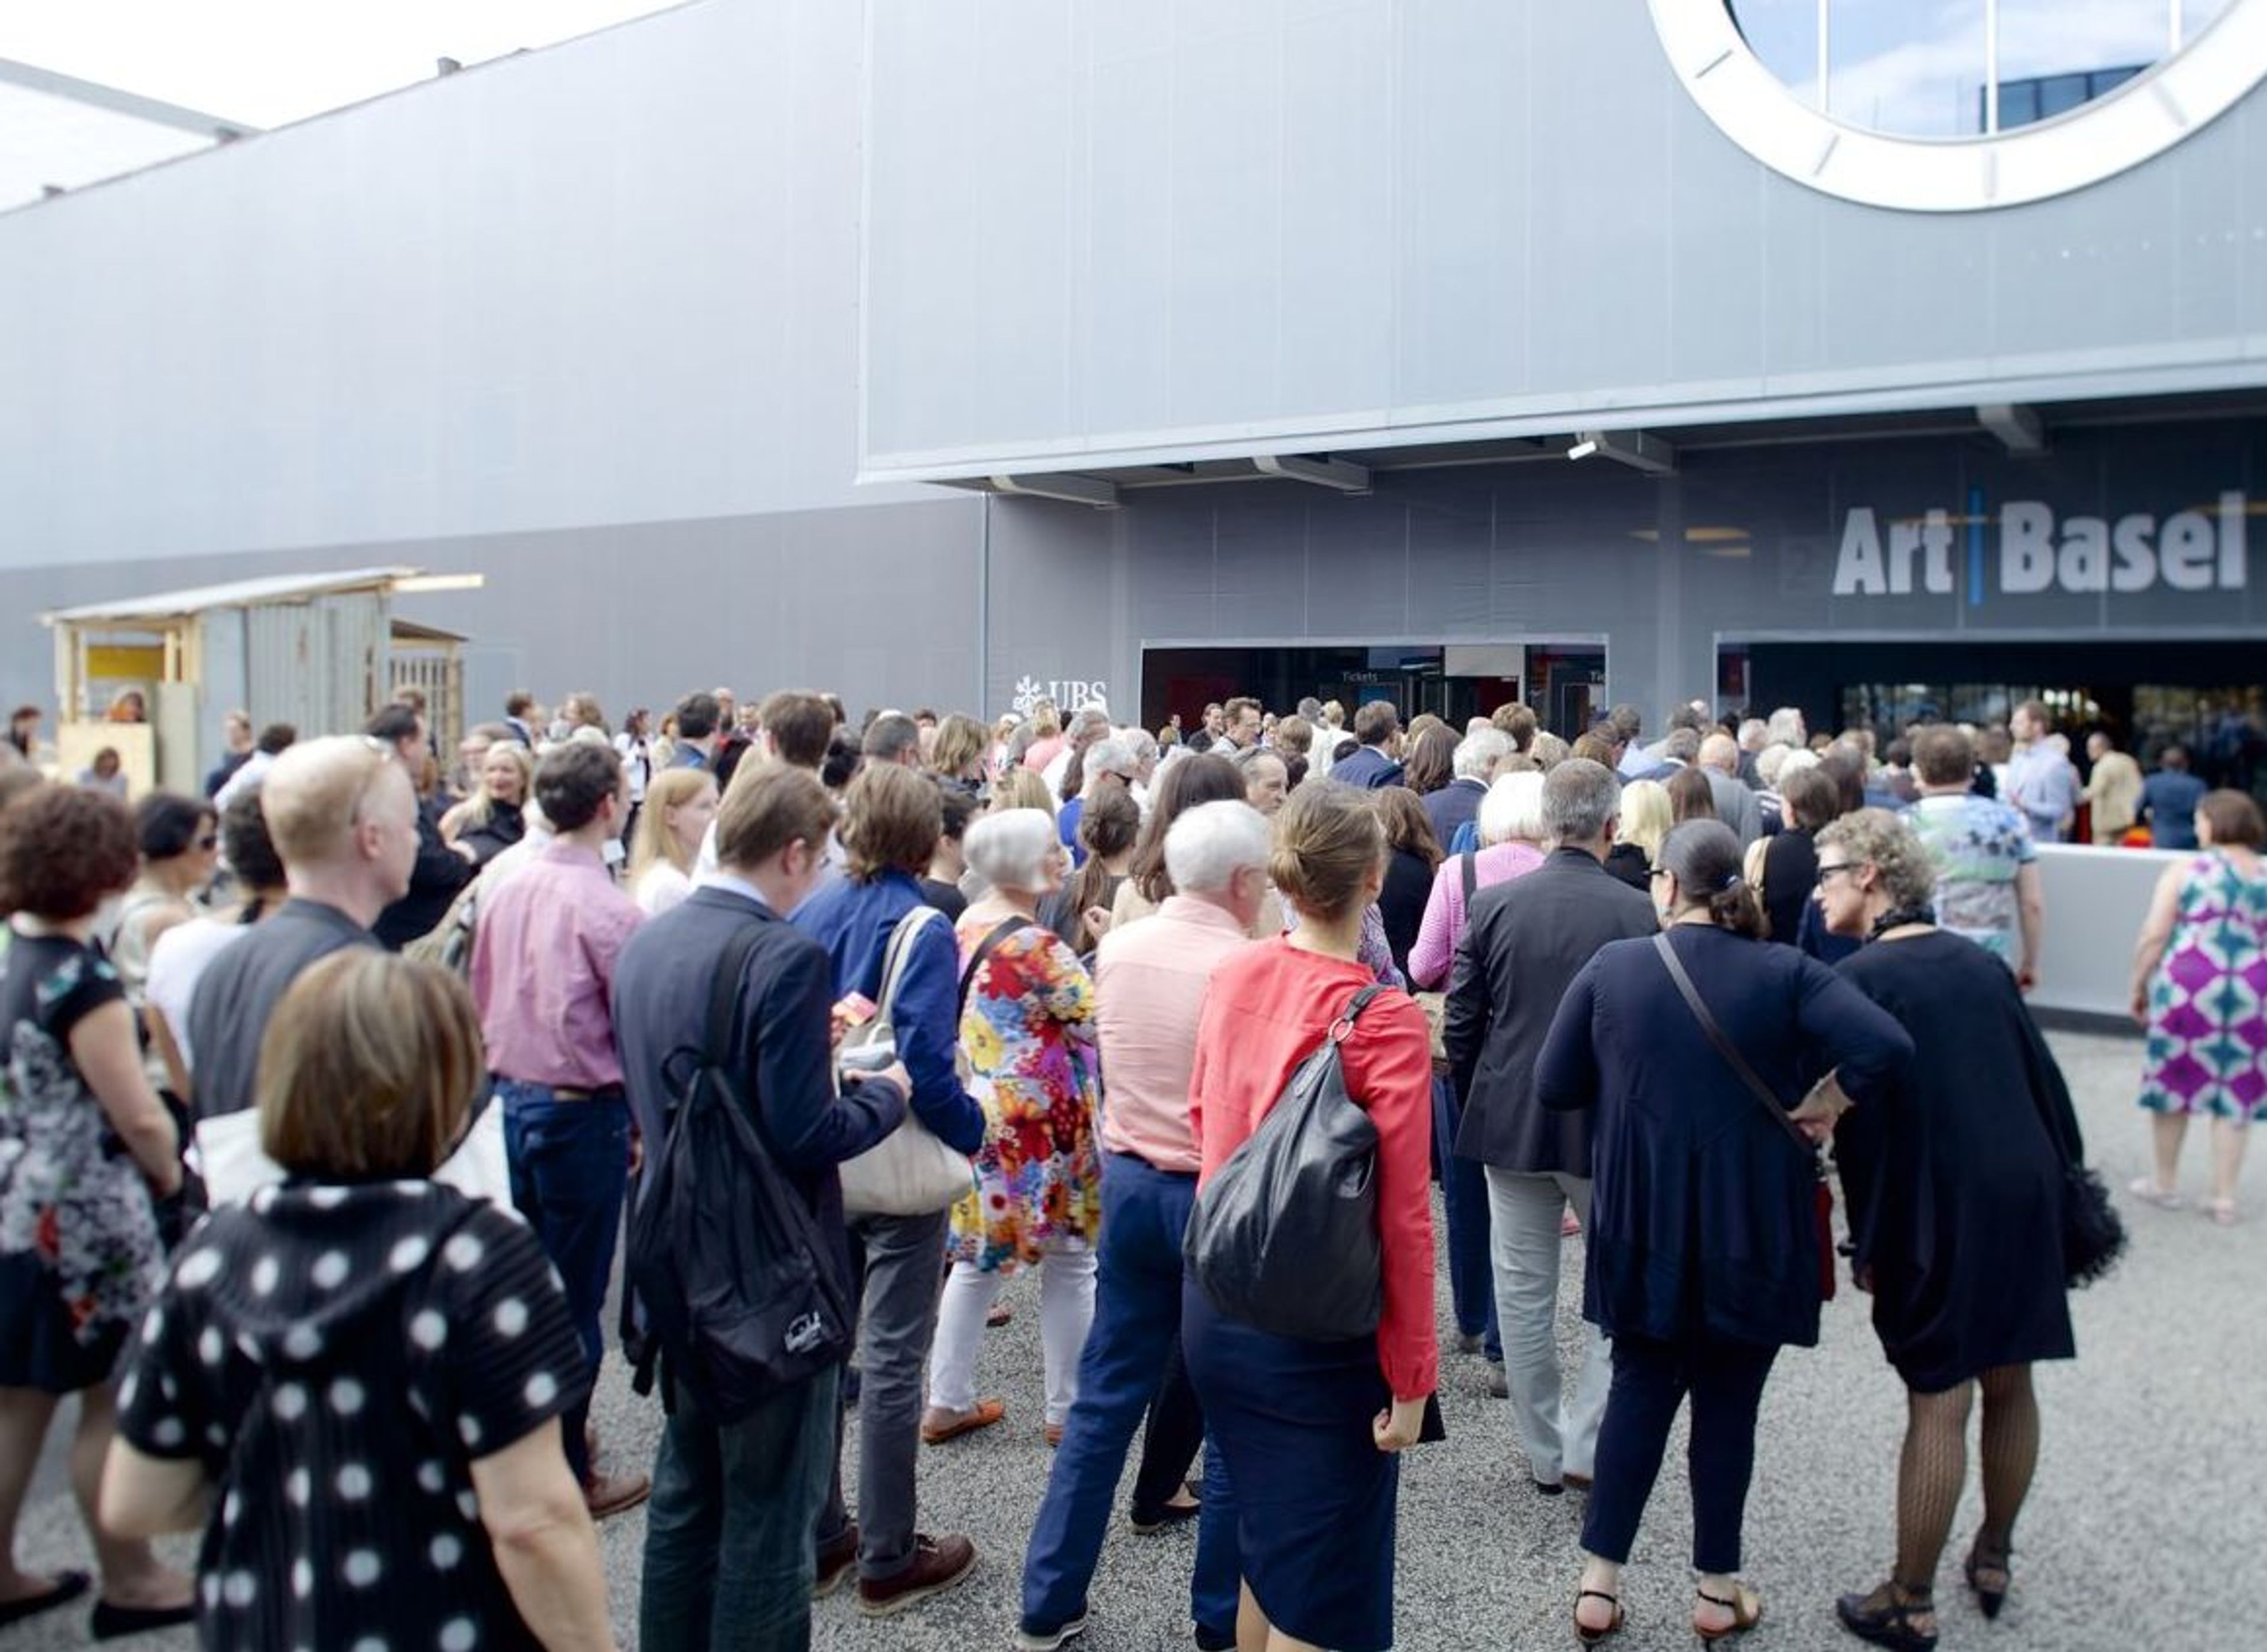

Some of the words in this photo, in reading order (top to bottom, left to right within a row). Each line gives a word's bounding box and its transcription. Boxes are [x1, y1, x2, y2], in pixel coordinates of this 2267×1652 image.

[1832, 507, 1953, 595] Art
[2000, 491, 2246, 592] Basel
[1342, 671, 1378, 683] Tickets
[1048, 680, 1107, 711] UBS
